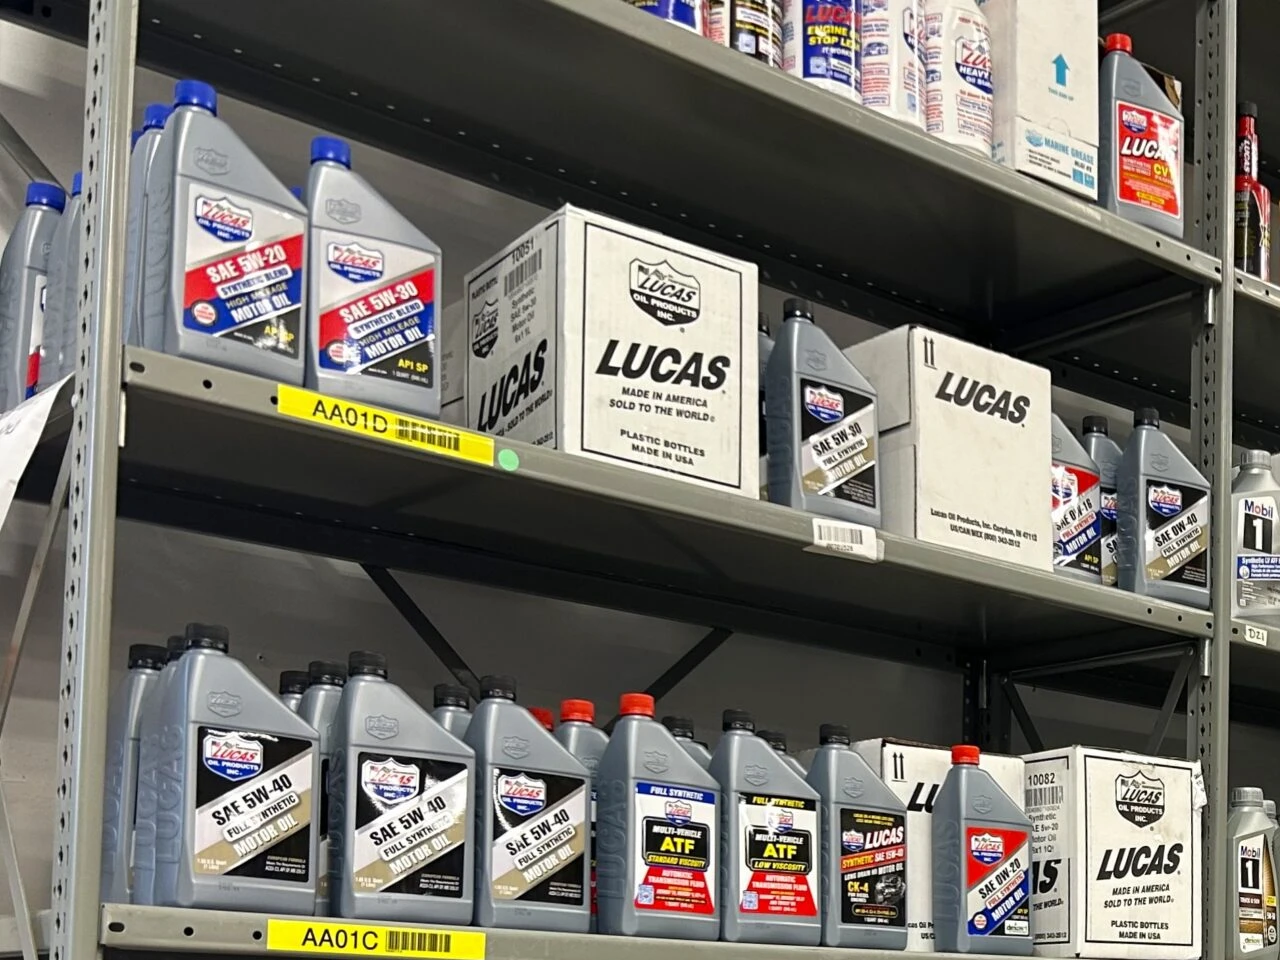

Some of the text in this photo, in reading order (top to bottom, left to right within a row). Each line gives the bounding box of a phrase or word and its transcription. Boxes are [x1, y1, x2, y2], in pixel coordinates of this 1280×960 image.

[808, 36, 838, 47] STOP
[1044, 136, 1095, 165] MARINE GREASE
[206, 245, 286, 283] SAE 5W-20
[333, 252, 380, 269] LUCAS
[511, 238, 534, 266] 10051
[339, 281, 418, 324] SAE 5W-30
[638, 276, 697, 304] LUCAS
[354, 301, 421, 336] SYNTHETIC BLEND
[633, 292, 698, 318] OIL PRODUCTS
[656, 310, 676, 322] INC.
[365, 327, 425, 360] MOTOR OIL
[398, 359, 429, 373] API SP
[596, 339, 730, 390] LUCAS
[478, 338, 548, 432] LUCAS
[622, 386, 708, 408] MADE IN AMERICA
[935, 370, 1031, 425] LUCAS
[312, 398, 388, 434] AA01D
[609, 398, 709, 422] SOLD TO THE WORLD
[620, 429, 705, 458] PLASTIC BOTTLES
[811, 421, 863, 457] SAE 5W-30
[632, 443, 694, 466] MADE IN USA
[1244, 500, 1273, 518] Mobil
[1154, 512, 1198, 548] SAE 0W-40
[1252, 518, 1264, 550] 1
[212, 746, 258, 761] LUCAS
[651, 786, 703, 800] FULL SYNTHETIC
[1027, 772, 1056, 786] 10082
[212, 773, 292, 826] SAE 5W-40
[660, 837, 695, 853] ATF
[864, 827, 904, 849] LUCAS
[1096, 843, 1181, 881] LUCAS
[1241, 846, 1261, 859] Mobil
[848, 881, 869, 893] CK-4
[979, 858, 1022, 900] SAE 0W-20
[301, 928, 379, 950] AA01C
